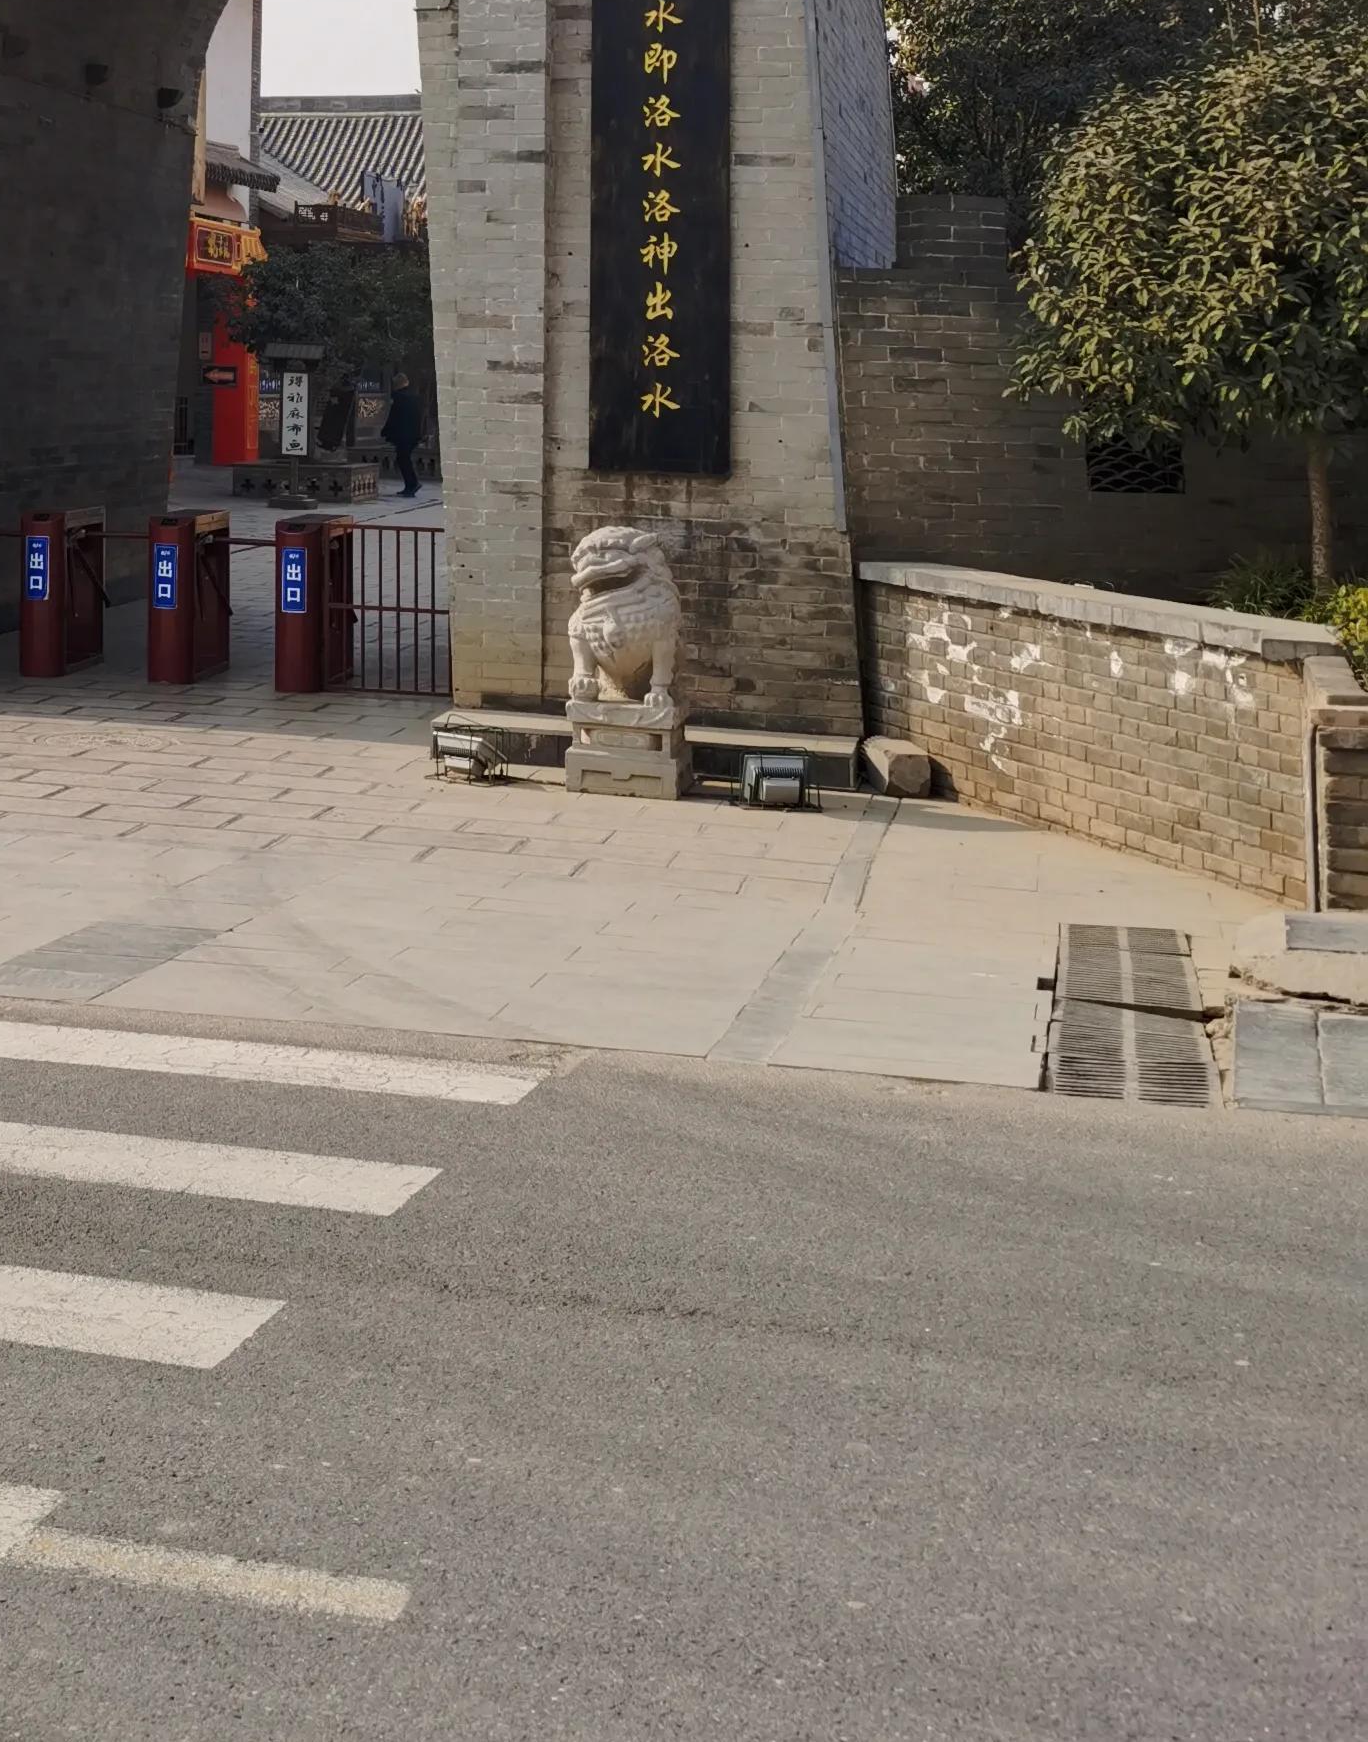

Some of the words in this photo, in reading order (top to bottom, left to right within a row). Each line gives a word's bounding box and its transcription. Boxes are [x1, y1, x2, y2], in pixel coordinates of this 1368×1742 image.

[29, 552, 44, 590] 出口
[158, 560, 173, 599] 出口
[286, 563, 302, 603] 出口
